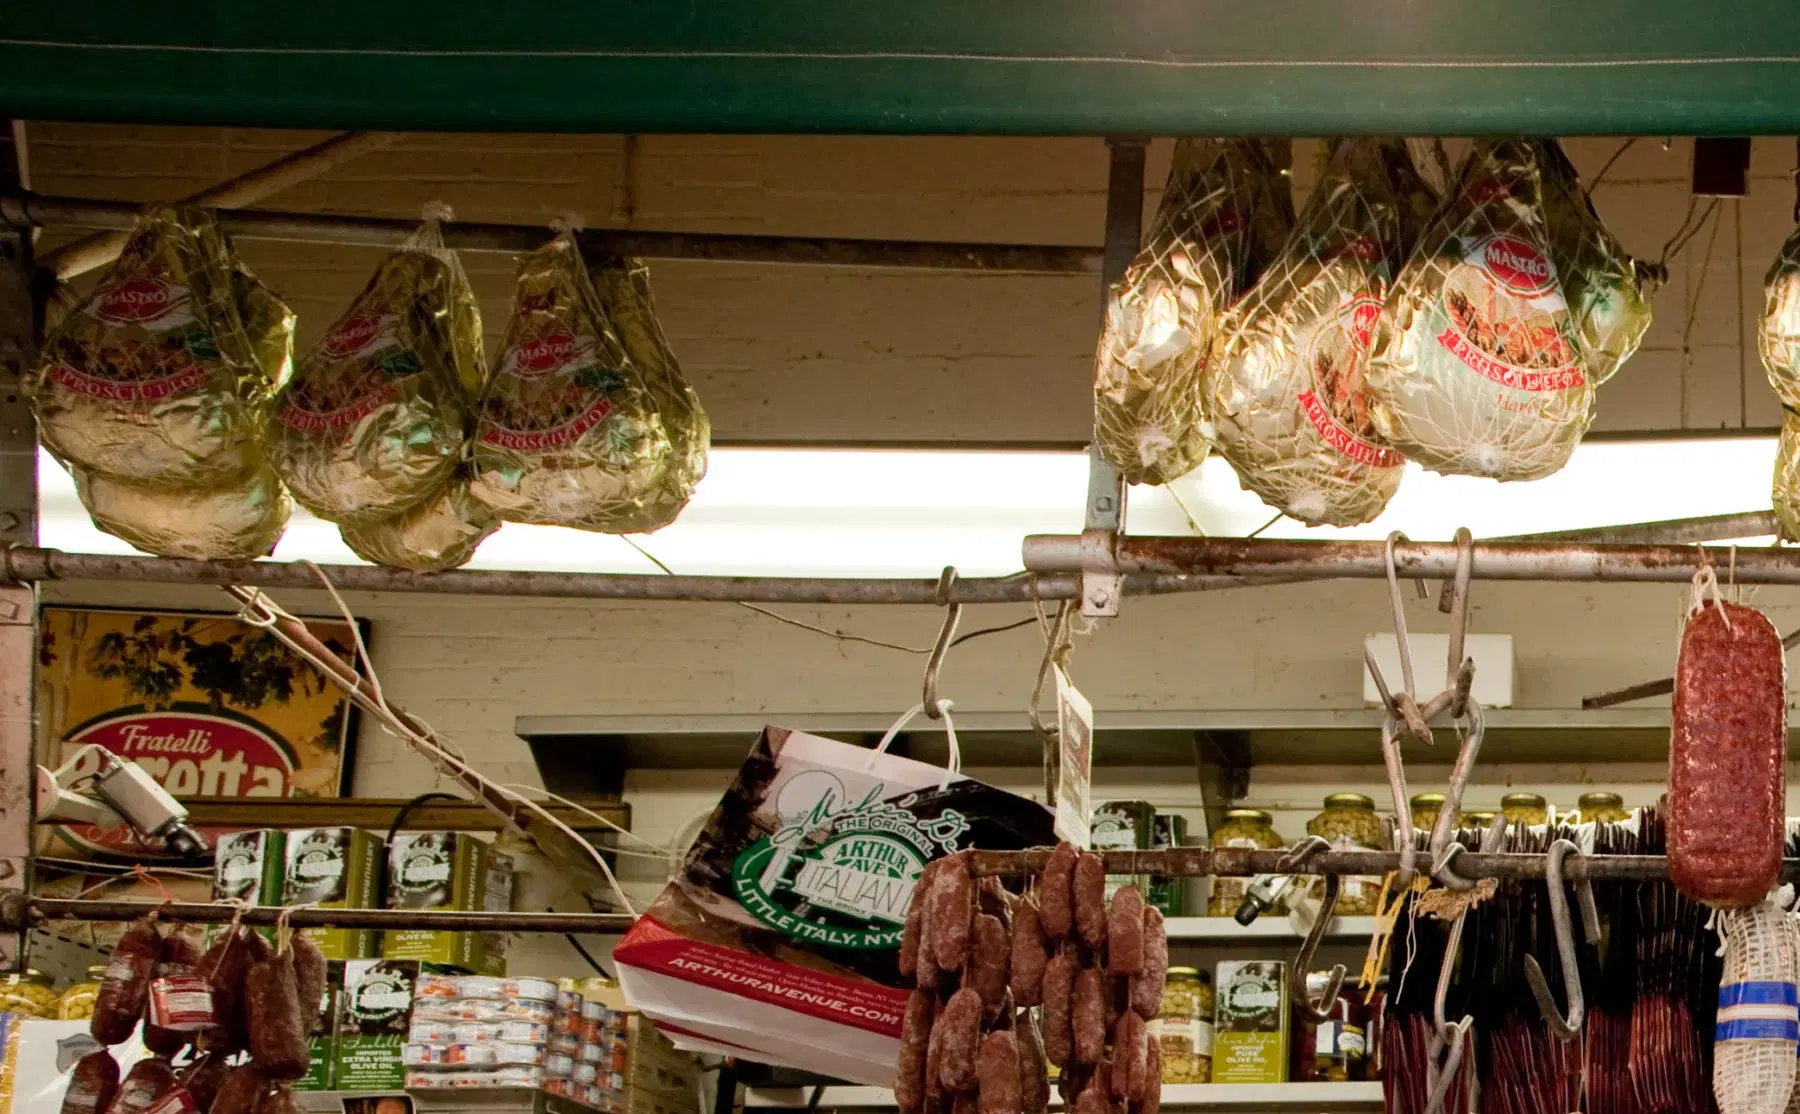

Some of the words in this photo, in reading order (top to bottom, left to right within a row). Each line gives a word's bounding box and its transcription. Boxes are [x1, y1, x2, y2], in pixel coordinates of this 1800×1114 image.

[1486, 245, 1550, 277] MASTRO
[1455, 338, 1577, 391] PROSCIUTTO
[61, 368, 198, 401] PROSCIUTTO
[119, 724, 213, 754] Fratelli
[773, 783, 918, 845] Mike's
[917, 808, 971, 855] De
[837, 817, 868, 831] THE
[870, 817, 935, 859] ORIGINAL
[833, 839, 910, 874] ARTHUR
[806, 865, 902, 914] ITALIAN
[735, 878, 795, 932] LITTLE
[794, 917, 858, 947] ITALY,
[668, 957, 900, 1026] ARTHURAVENUE.COM
[342, 1056, 372, 1064] EXTRA
[350, 1062, 378, 1070] OLIVE
[378, 1062, 395, 1070] OIL
[1226, 1056, 1251, 1064] OLIVE
[1252, 1056, 1267, 1064] OIL
[1235, 1050, 1258, 1058] PURE
